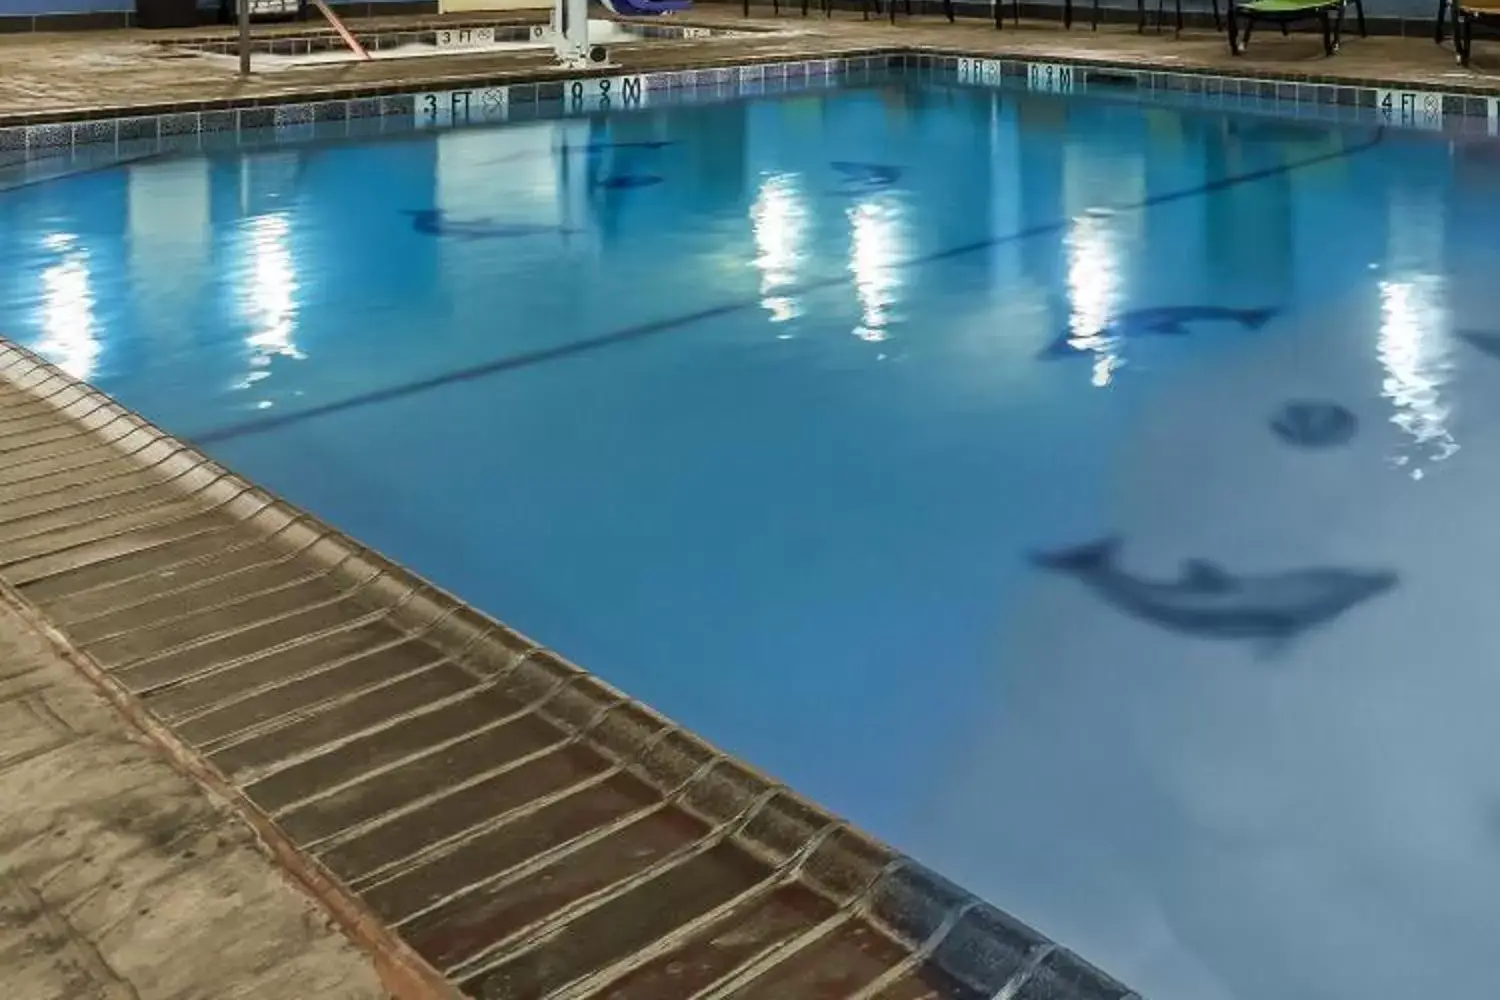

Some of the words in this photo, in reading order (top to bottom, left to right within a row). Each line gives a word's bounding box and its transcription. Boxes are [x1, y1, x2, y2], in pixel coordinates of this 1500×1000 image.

[442, 31, 451, 43] 3
[459, 30, 473, 42] FT
[424, 94, 437, 113] 3
[451, 91, 473, 111] FT
[1382, 91, 1393, 108] 4
[1401, 93, 1416, 110] FT
